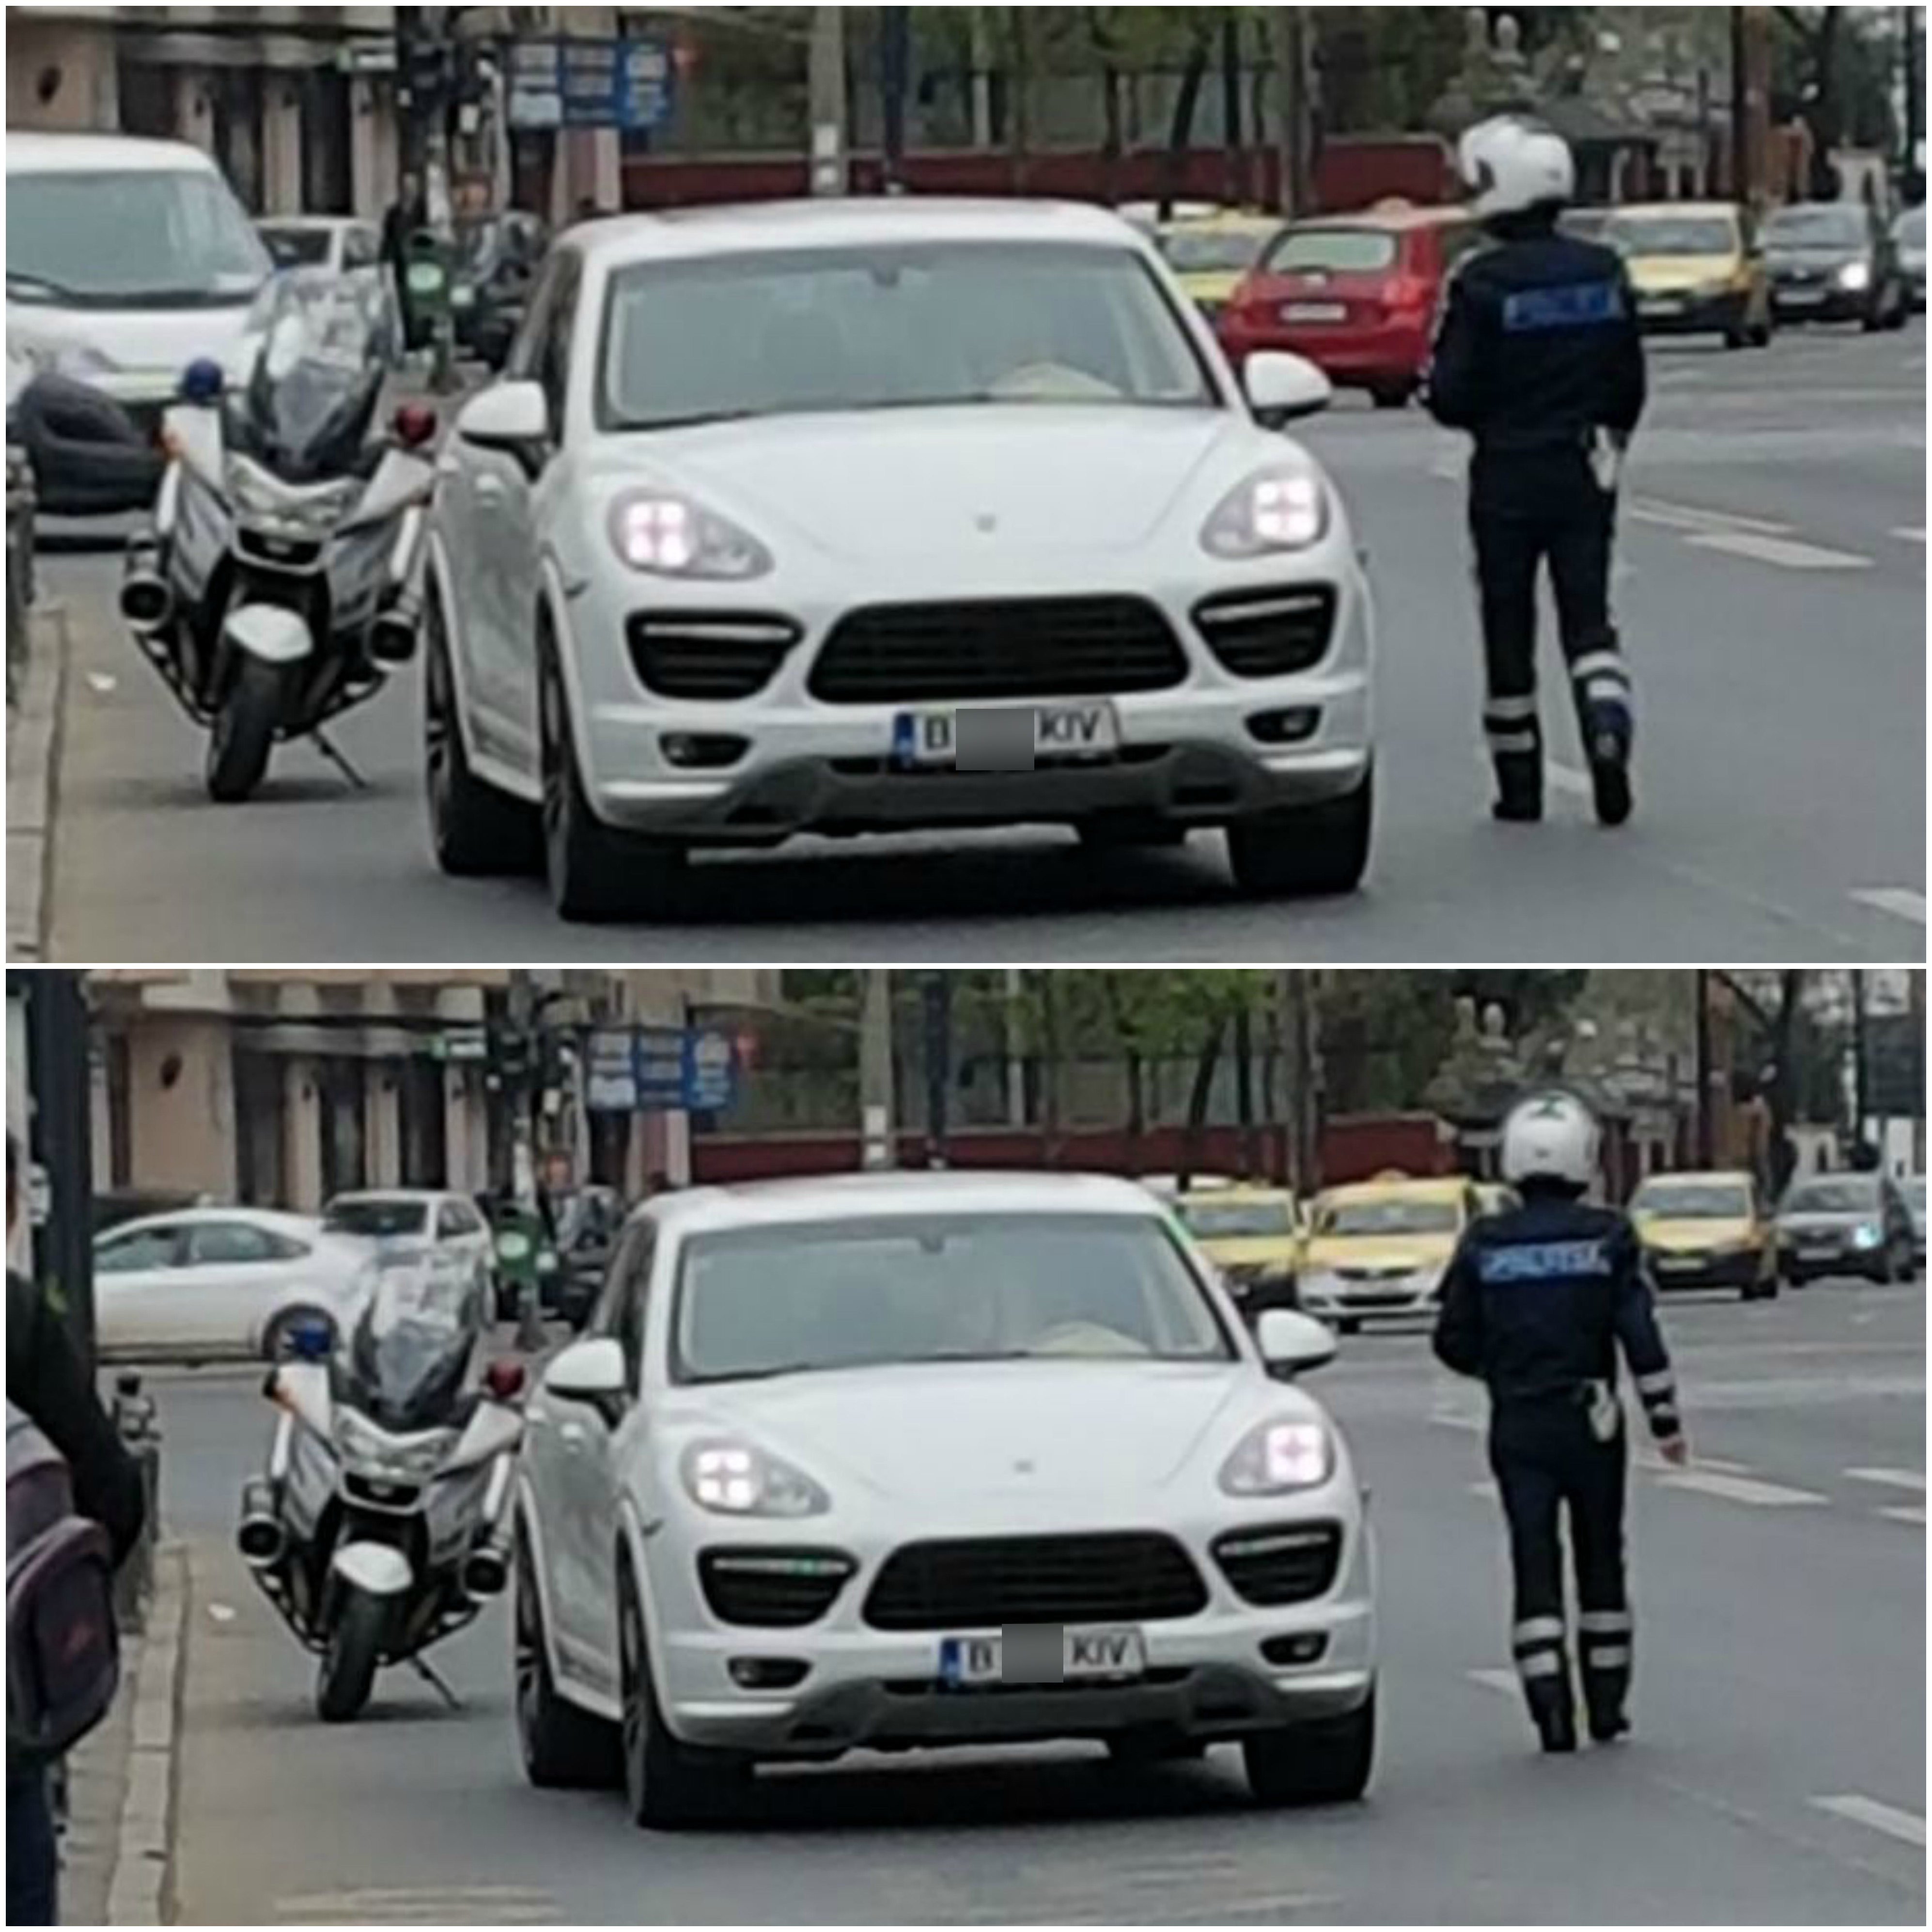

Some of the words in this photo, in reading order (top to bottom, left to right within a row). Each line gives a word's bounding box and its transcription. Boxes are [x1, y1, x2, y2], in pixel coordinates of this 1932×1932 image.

[925, 716, 950, 749] B
[1038, 709, 1101, 741] KIV
[969, 1640, 993, 1672] B
[1071, 1635, 1128, 1666] KIV
